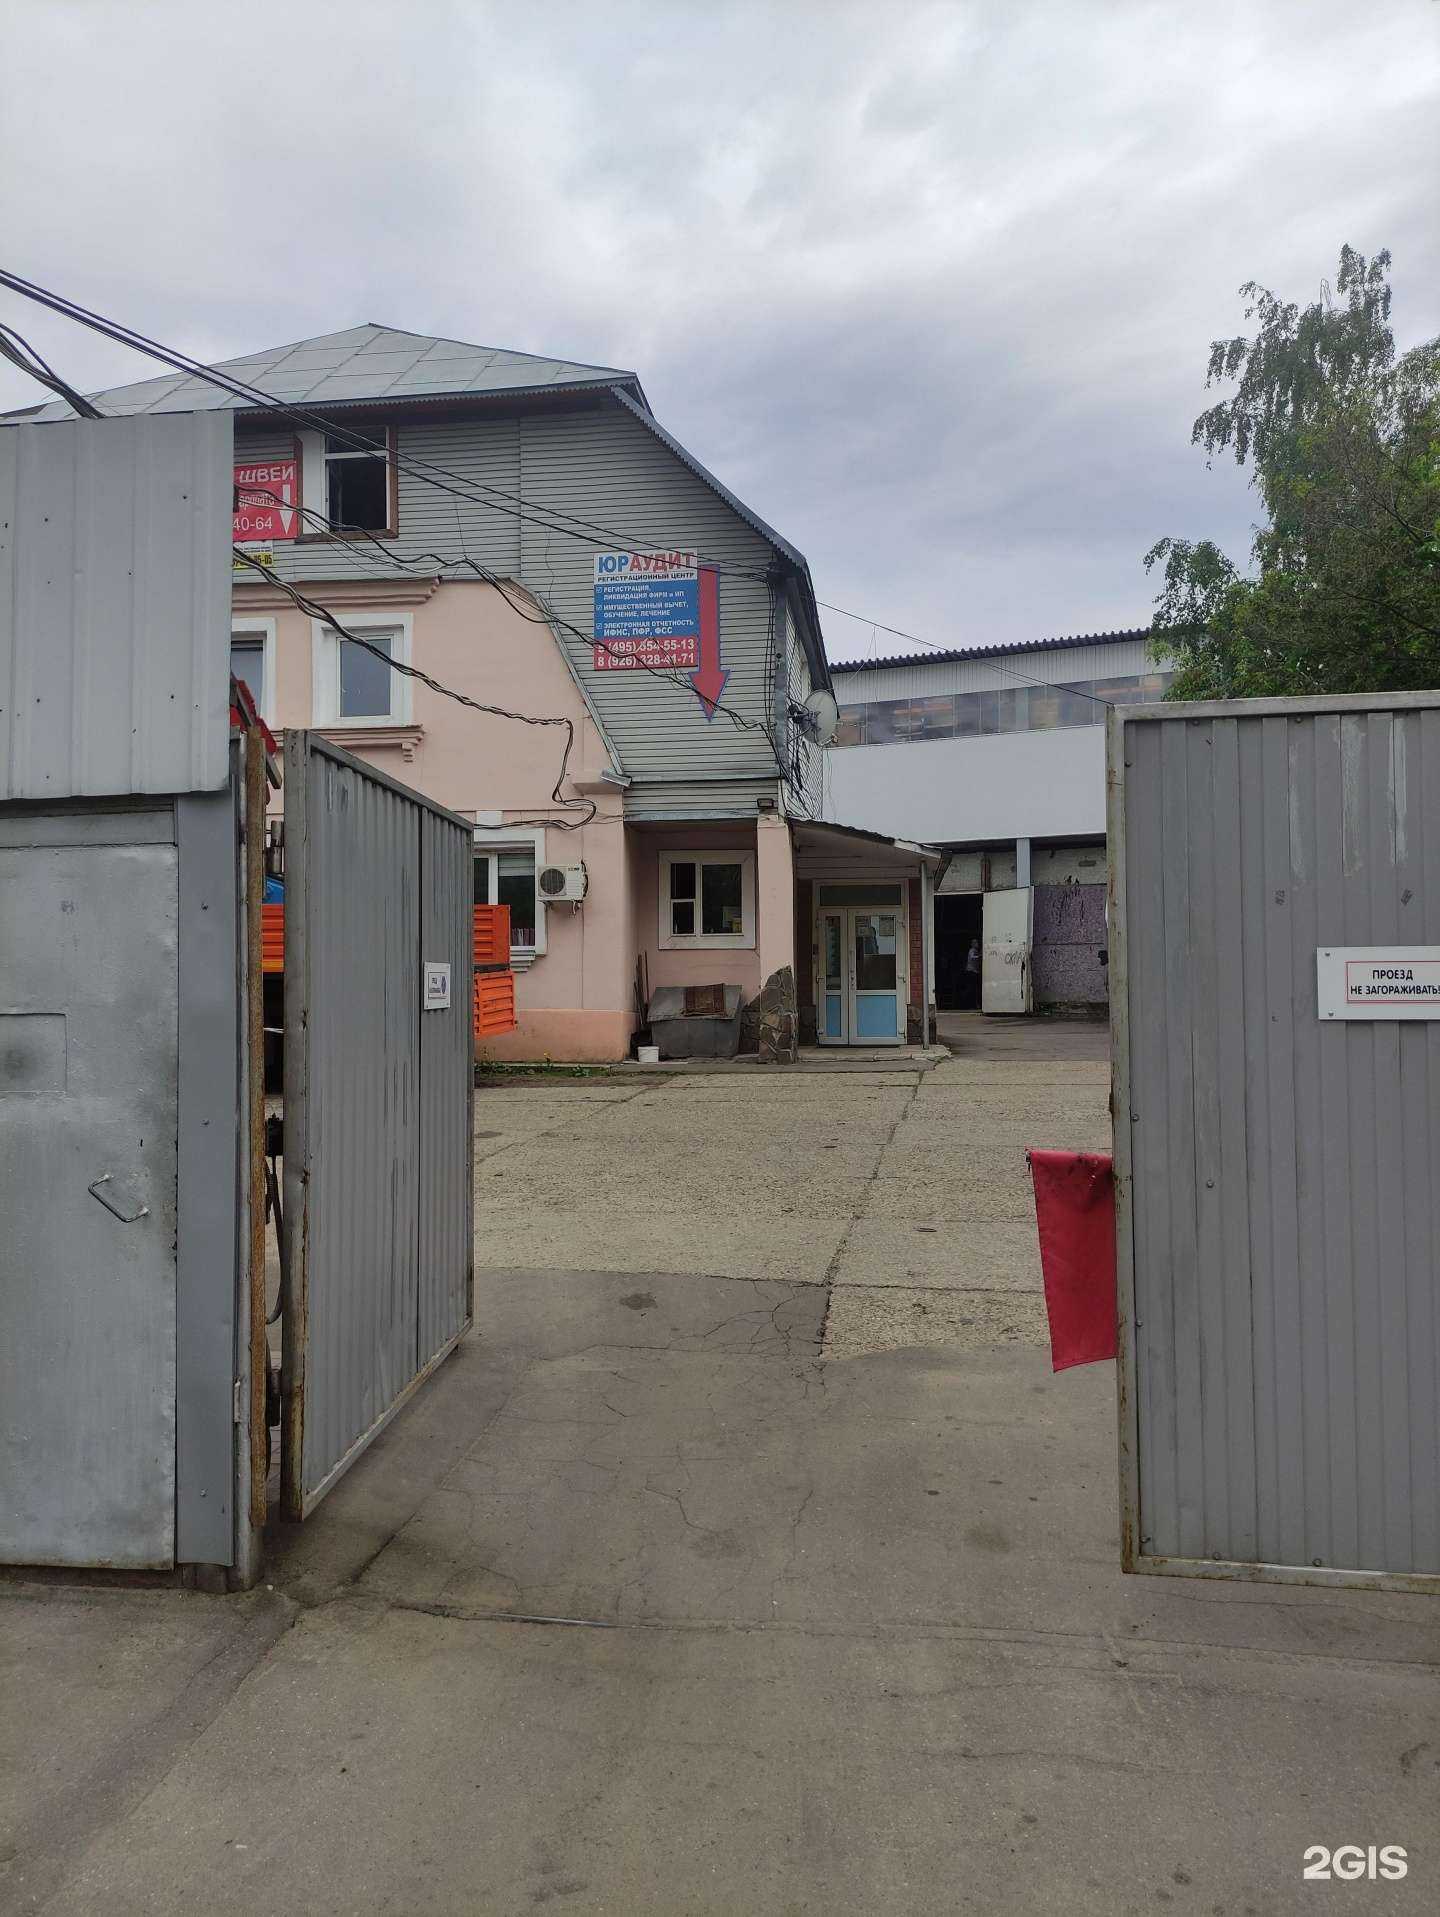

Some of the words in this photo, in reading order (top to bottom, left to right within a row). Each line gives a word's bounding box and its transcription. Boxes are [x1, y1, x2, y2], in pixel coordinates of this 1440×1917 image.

[598, 552, 695, 574] ЮРАУДИТ
[598, 574, 669, 582] РЕГИСТРАЦИОННЫЙ
[671, 572, 695, 580] ЦЕНТР
[604, 593, 647, 601] ЛИКВИДАЦИЯ
[604, 602, 663, 610] ИМУЩЕСТВЕННЫЙ
[604, 621, 650, 629] ЭЛЕКТРОННАЯ
[651, 619, 694, 627] ОТЧЕТНОСТЬ
[604, 628, 630, 637] ИФНС,
[632, 627, 652, 636] ПФР,
[608, 641, 636, 653] (495)
[598, 656, 605, 667] 8
[1372, 969, 1414, 981] ПРОЕЗД
[1350, 985, 1362, 995] НЕ
